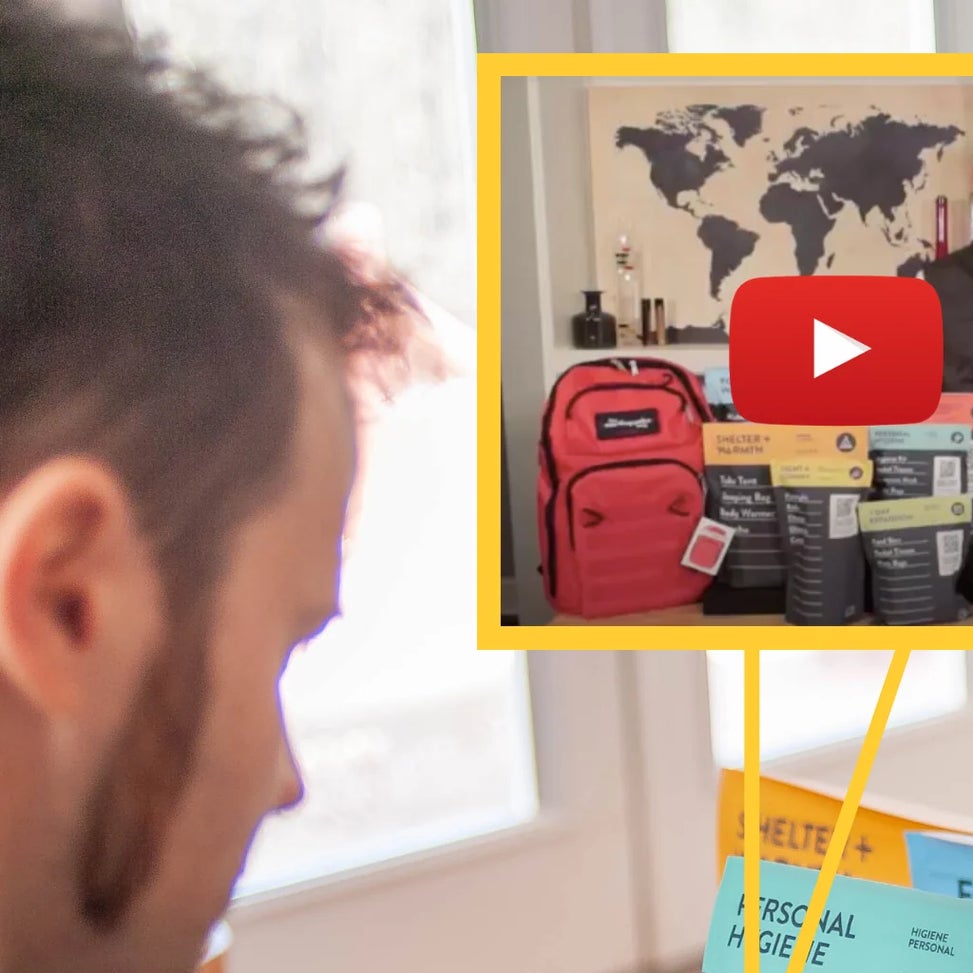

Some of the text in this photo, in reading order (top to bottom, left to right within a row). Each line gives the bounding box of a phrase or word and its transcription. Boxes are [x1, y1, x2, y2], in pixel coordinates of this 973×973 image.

[737, 809, 849, 861] HELTE
[737, 893, 857, 940] RSONAL
[911, 927, 950, 943] HIGIENE
[727, 924, 831, 967] HGIEE
[908, 938, 956, 957] PERSONAL
